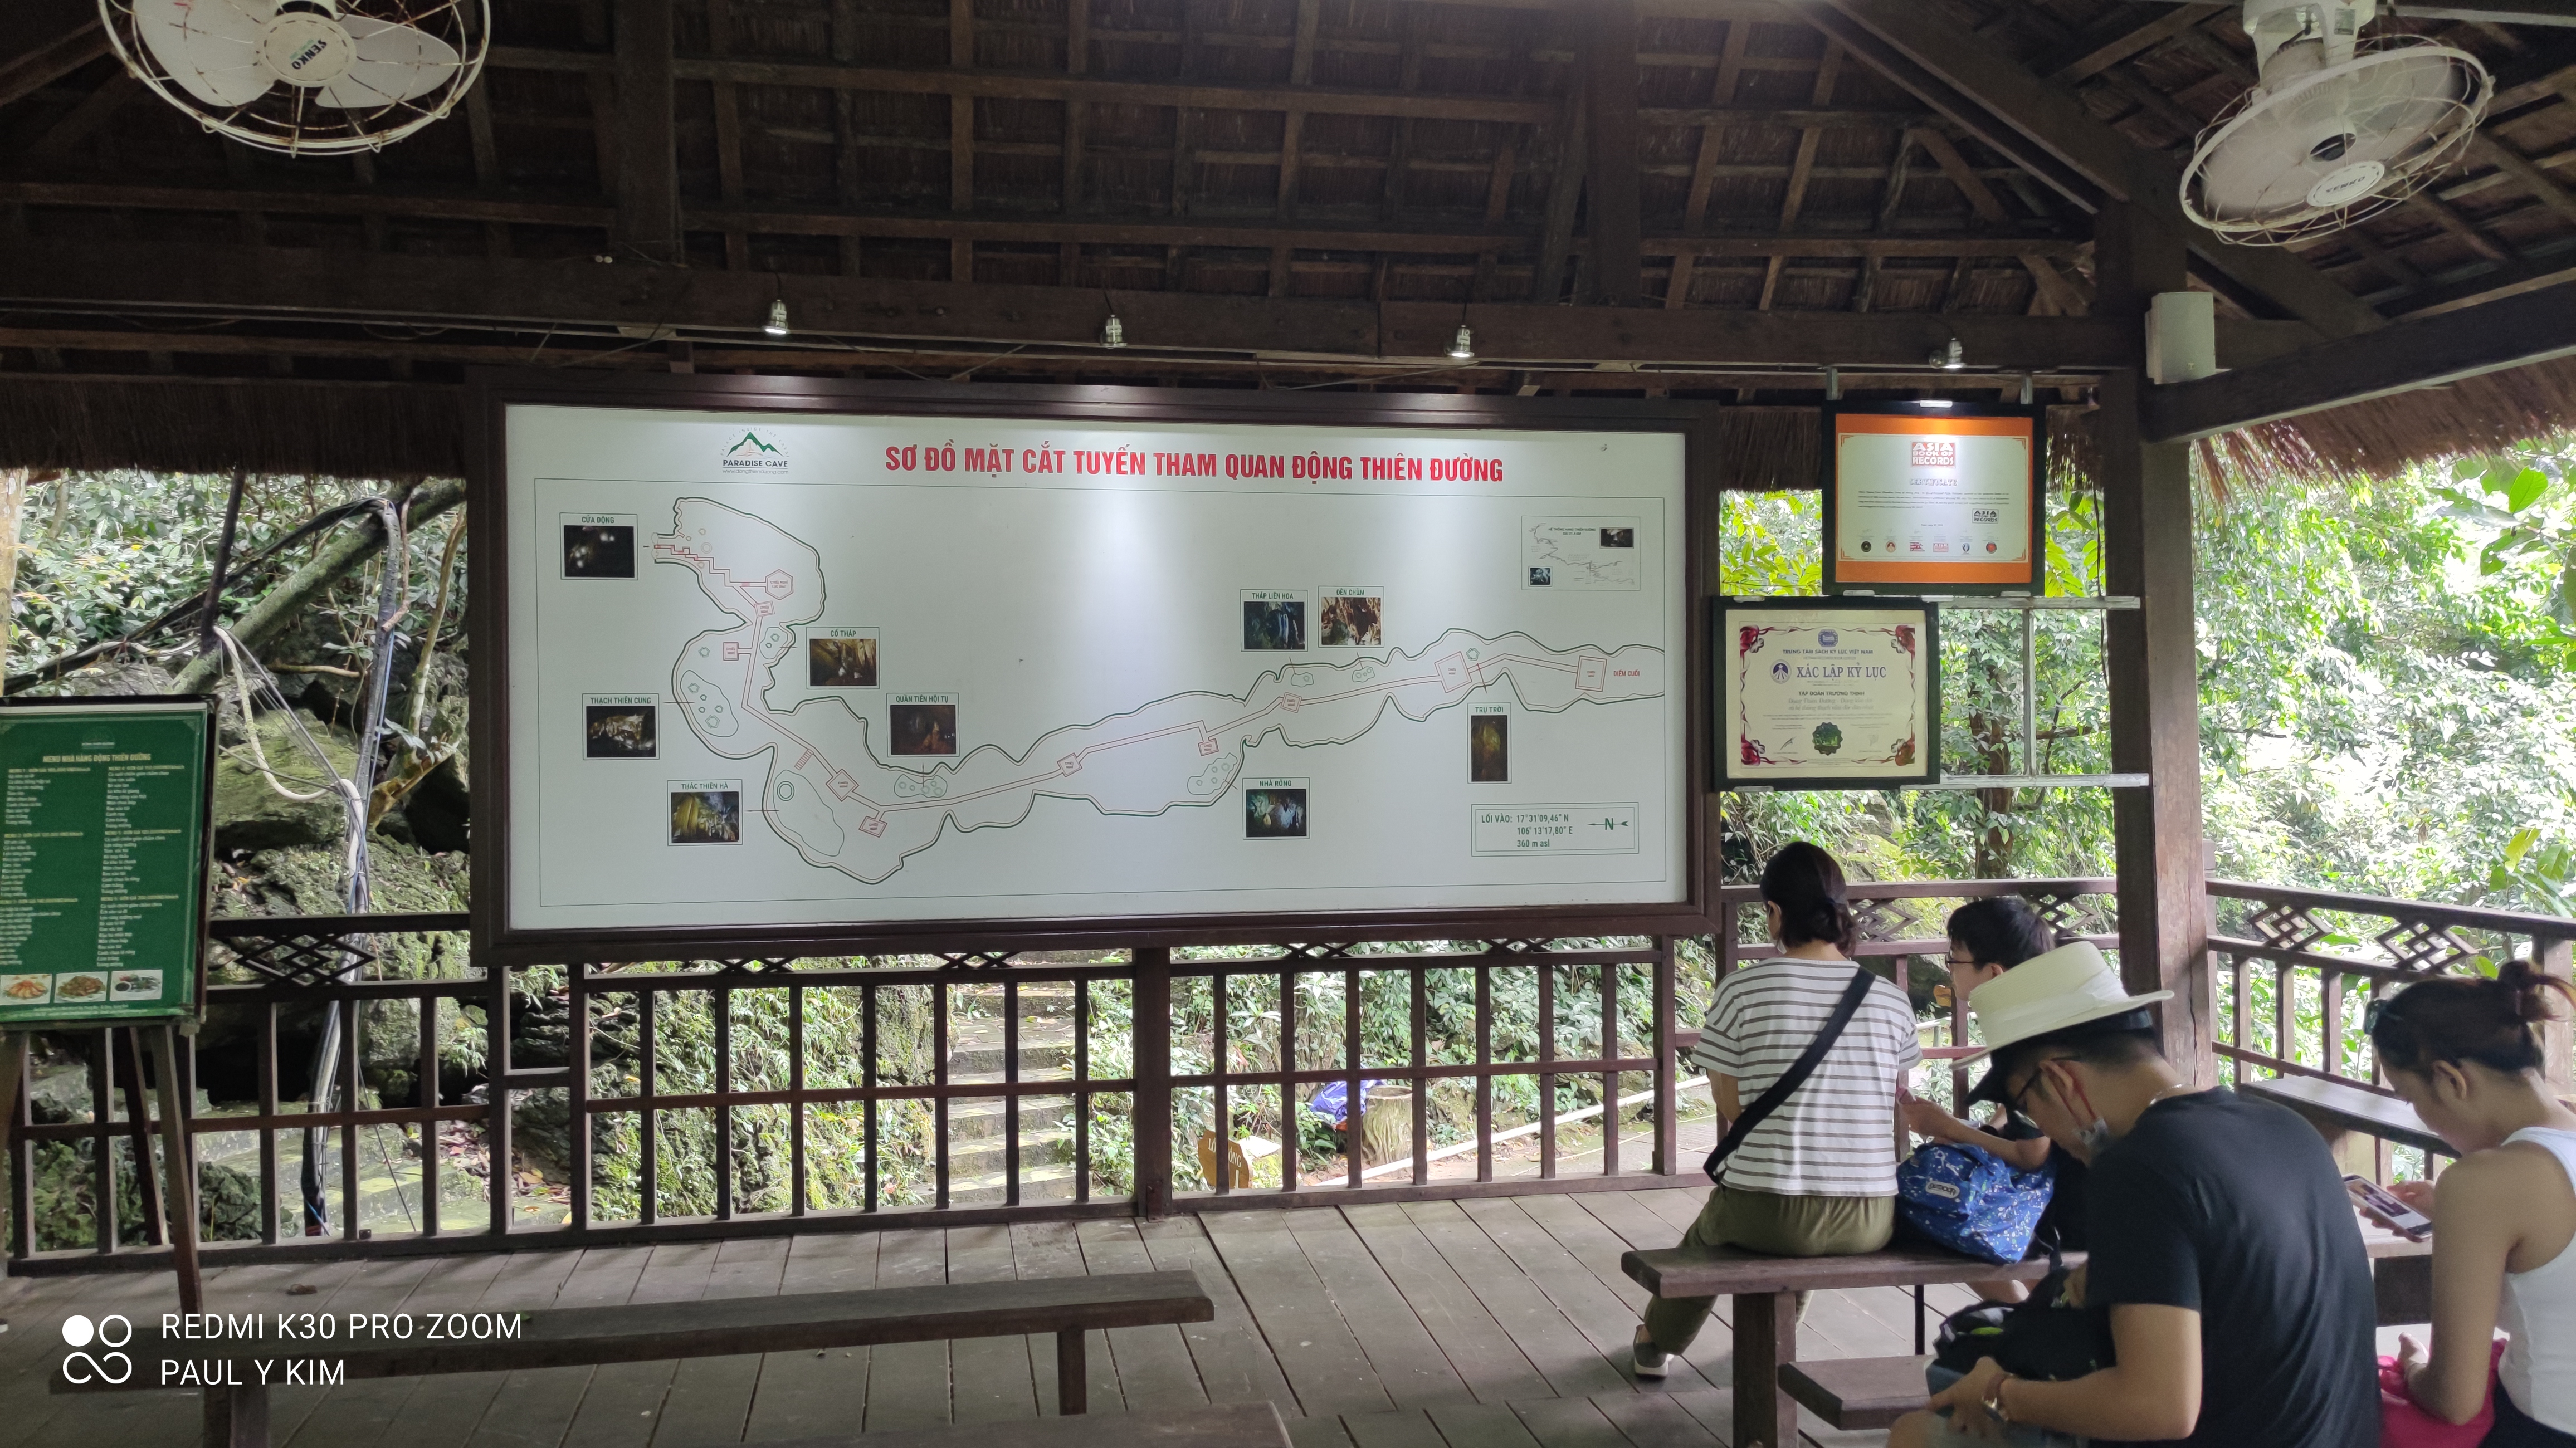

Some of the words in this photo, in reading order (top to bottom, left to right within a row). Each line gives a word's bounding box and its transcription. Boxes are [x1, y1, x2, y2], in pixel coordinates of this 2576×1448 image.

[291, 39, 327, 70] SENKO
[766, 429, 777, 438] THE
[1913, 442, 1954, 452] ASIA
[886, 444, 918, 472] SƠ
[924, 439, 956, 472] ĐỒ
[964, 443, 1014, 478] MẶT
[1022, 440, 1066, 474] CẮT
[1072, 444, 1147, 476] TUYẾN
[1153, 452, 1217, 477] THAM
[1225, 454, 1284, 480] QUAN
[1292, 451, 1353, 485] ĐỘNG
[1359, 452, 1422, 481] THIÊN
[1429, 453, 1503, 482] ĐƯỜNG
[1913, 456, 1954, 465] RECORDS
[1796, 663, 1819, 678] XÁC
[1823, 664, 1843, 681] LẬP
[1847, 662, 1862, 678] KỶ
[1865, 667, 1886, 681] LỤC
[929, 694, 939, 703] HỘI
[1495, 813, 1513, 823] VÀO:
[1605, 818, 1613, 830] N
[1540, 839, 1550, 847] asl
[1928, 1183, 1956, 1196] OUTDOOR
